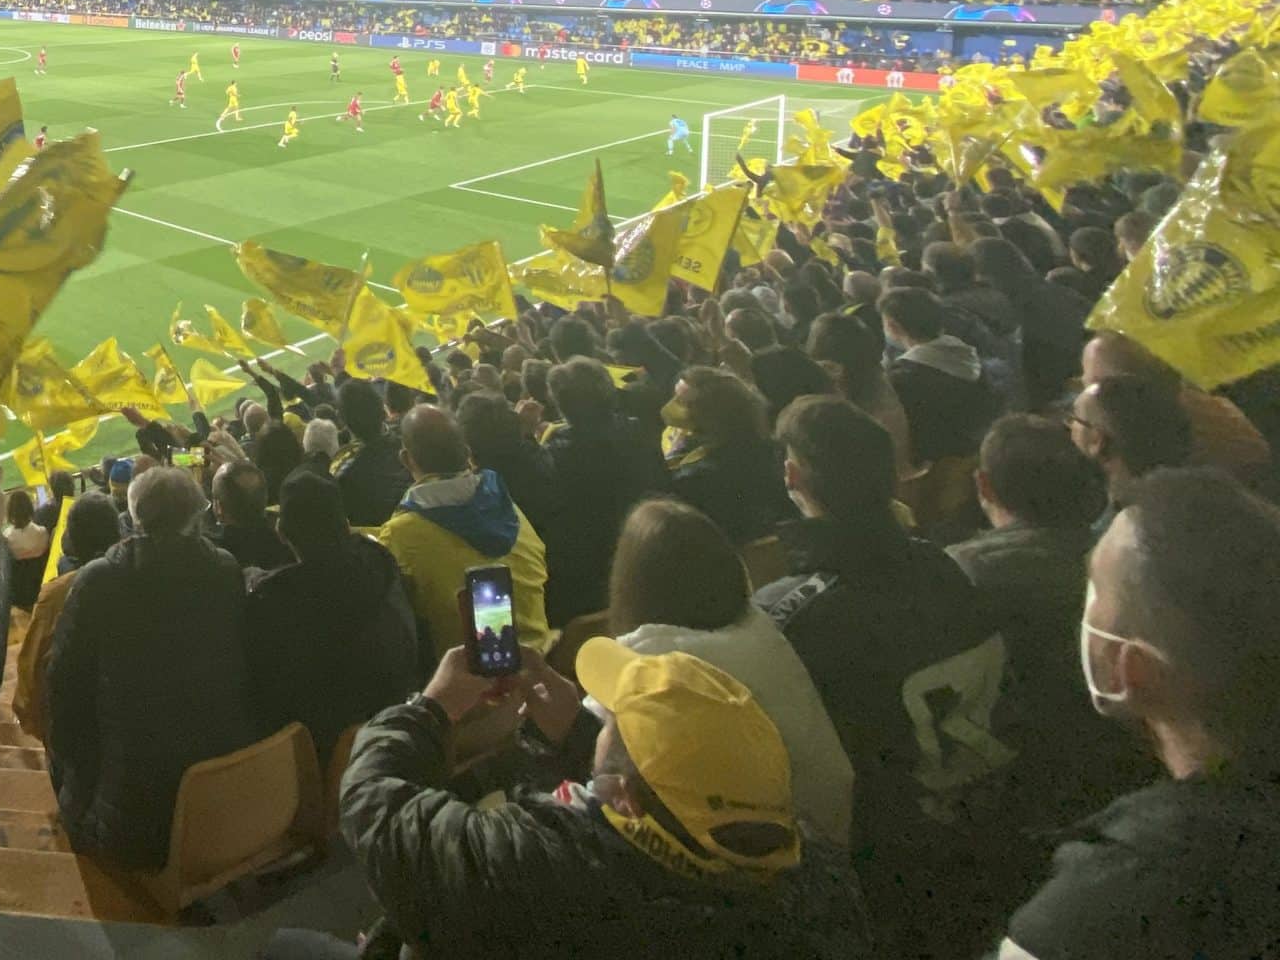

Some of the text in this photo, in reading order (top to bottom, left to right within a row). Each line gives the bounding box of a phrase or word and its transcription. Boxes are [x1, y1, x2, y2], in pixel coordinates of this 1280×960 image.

[135, 20, 176, 30] Heineken
[299, 31, 332, 42] pepsi
[413, 40, 446, 49] PS5
[676, 59, 708, 70] PEACE
